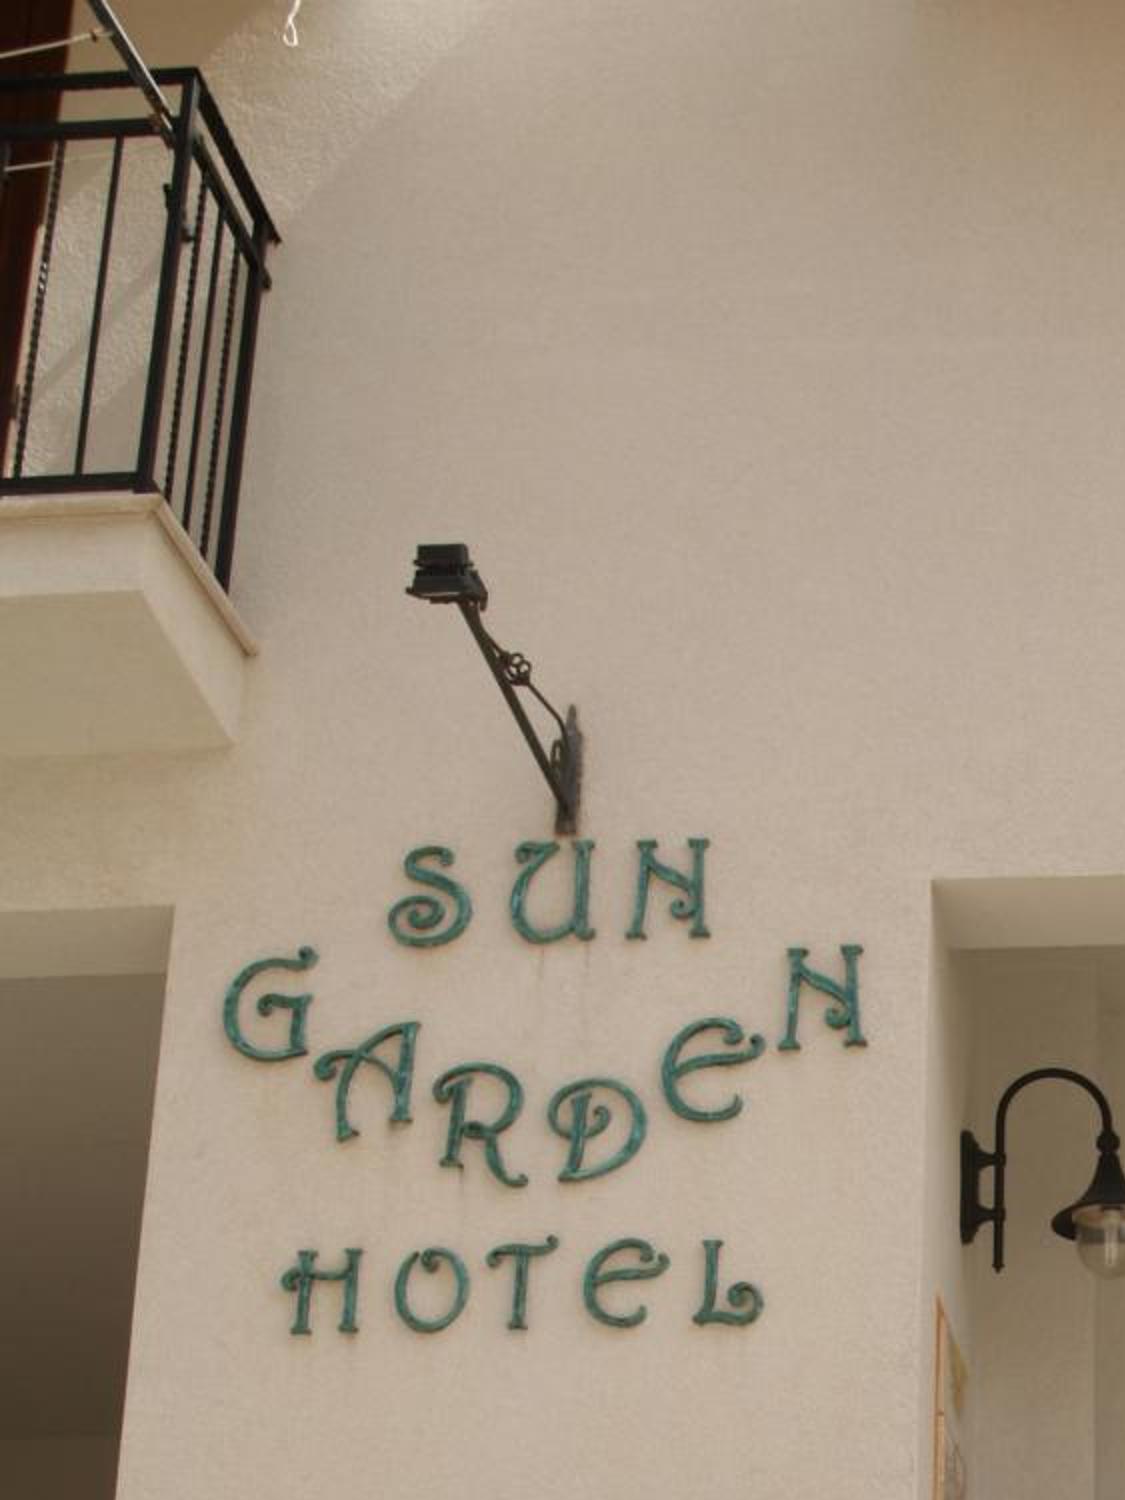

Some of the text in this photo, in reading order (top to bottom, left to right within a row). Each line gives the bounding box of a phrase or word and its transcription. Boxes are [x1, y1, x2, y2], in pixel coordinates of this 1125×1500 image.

[388, 837, 711, 949] SUN
[223, 944, 868, 1188] GARDEN
[281, 1234, 764, 1336] HOTEL
